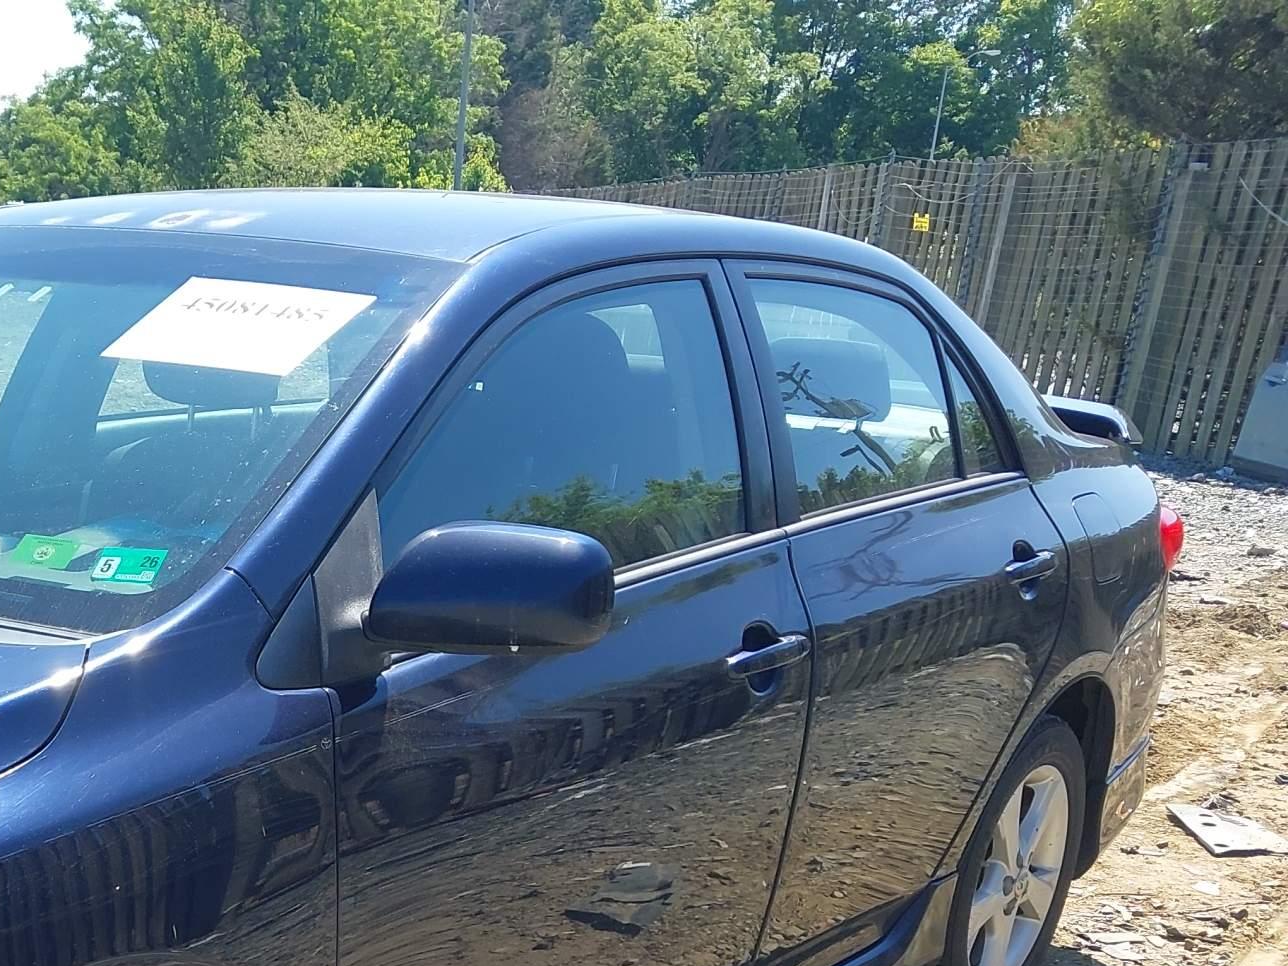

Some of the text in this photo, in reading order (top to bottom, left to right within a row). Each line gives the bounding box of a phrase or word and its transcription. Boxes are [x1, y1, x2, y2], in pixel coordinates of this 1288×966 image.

[180, 297, 329, 321] 45081485
[100, 556, 161, 573] 5 26
